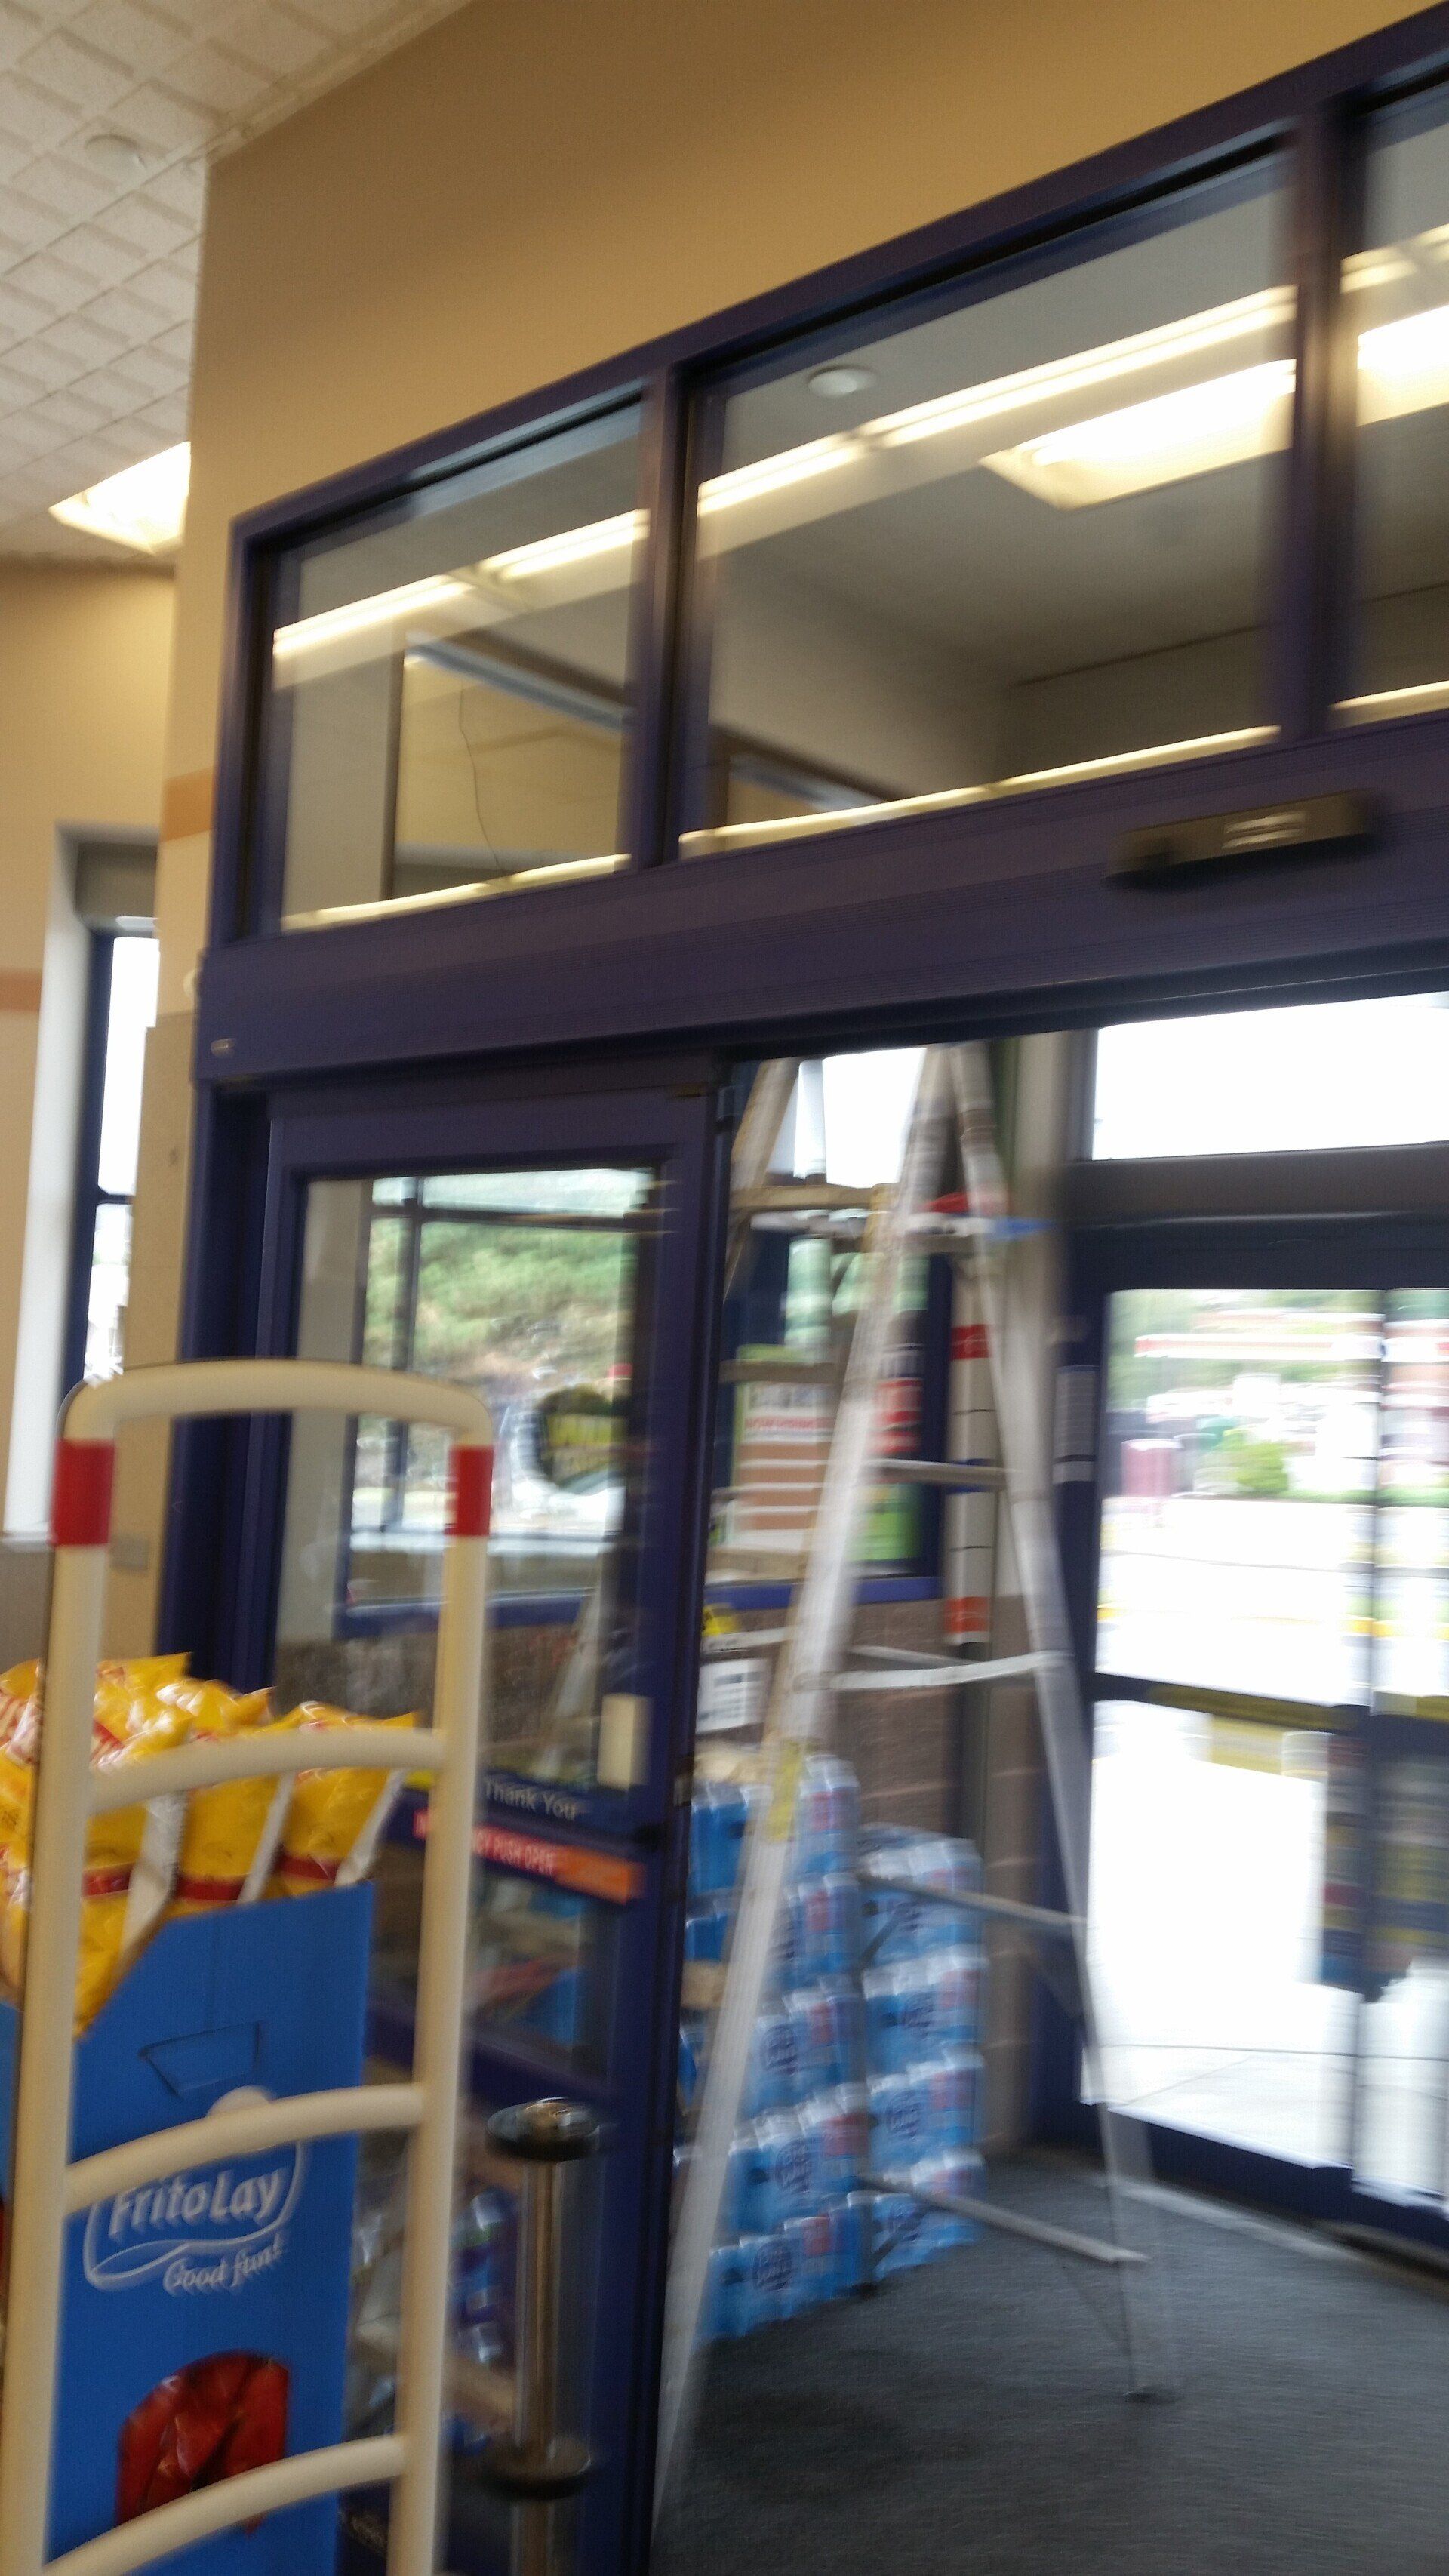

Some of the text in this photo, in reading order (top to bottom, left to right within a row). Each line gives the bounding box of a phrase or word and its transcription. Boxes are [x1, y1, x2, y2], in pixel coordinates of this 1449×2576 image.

[485, 1779, 577, 1820] Thank You
[163, 2257, 228, 2296] Good
